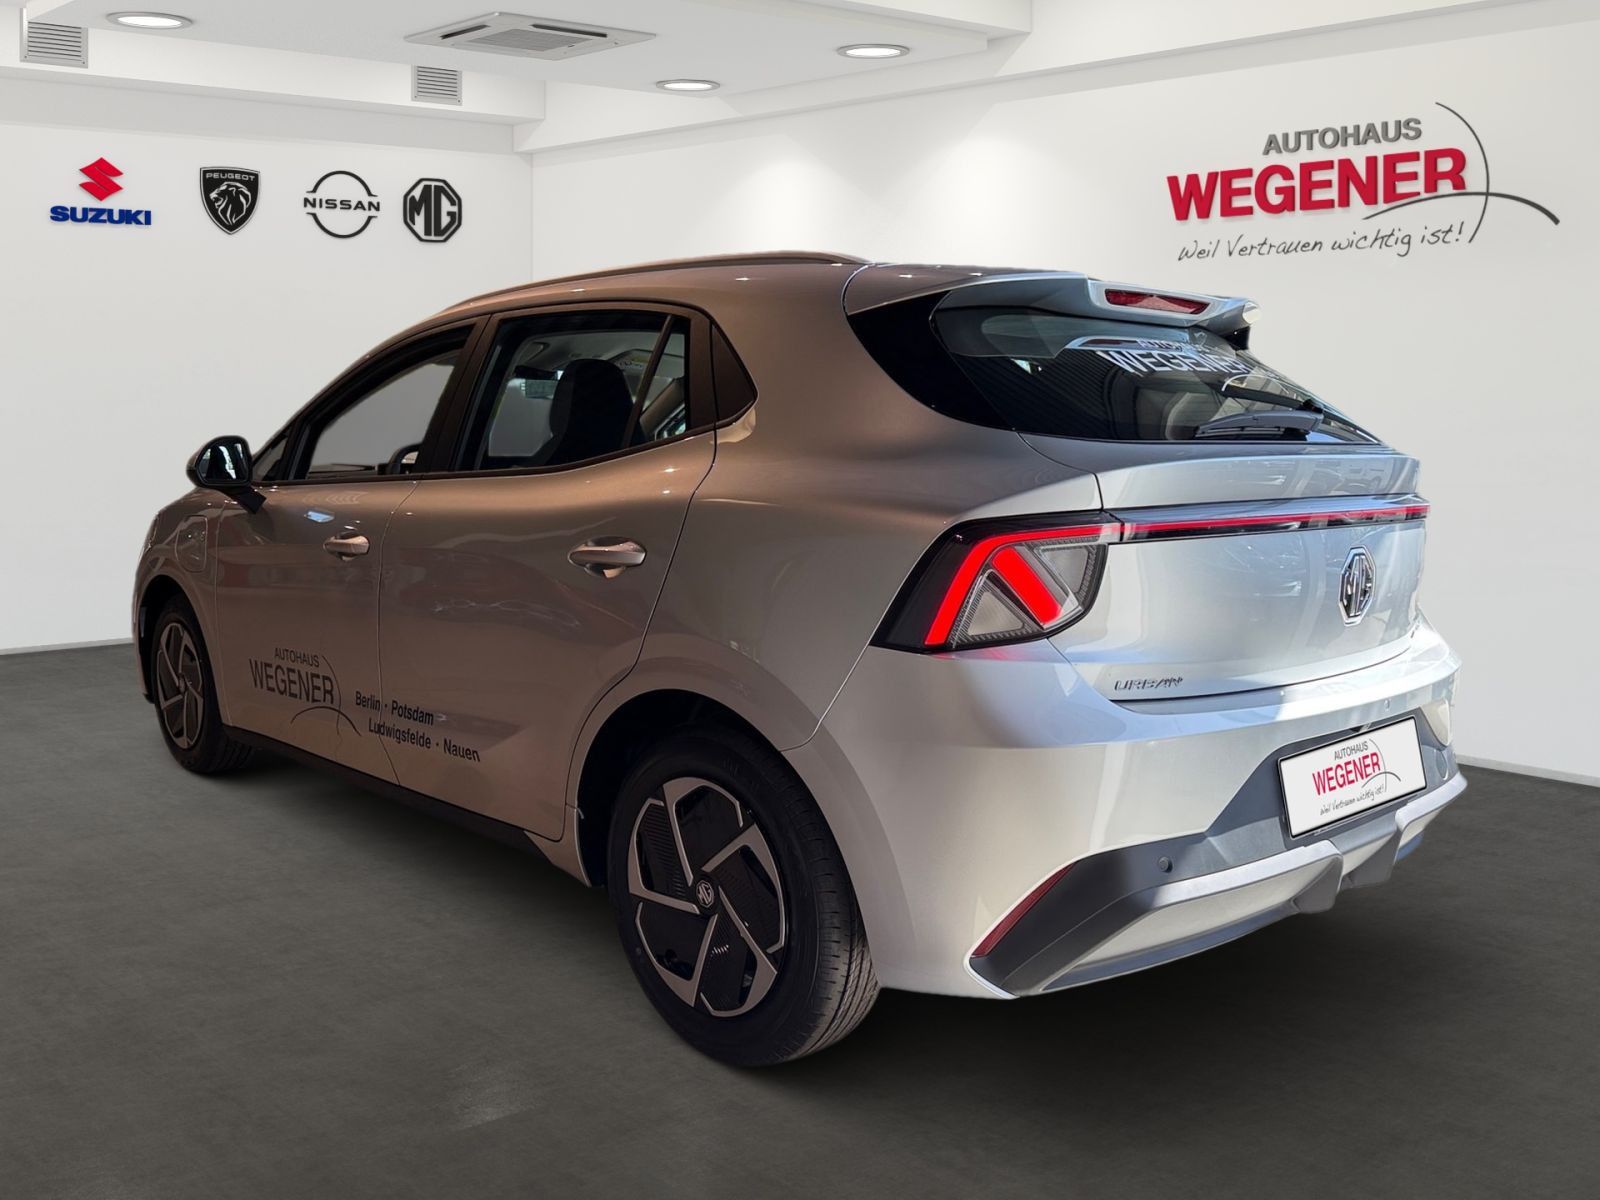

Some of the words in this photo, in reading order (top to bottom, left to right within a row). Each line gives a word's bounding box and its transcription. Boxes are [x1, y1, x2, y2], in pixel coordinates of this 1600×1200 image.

[1263, 118, 1422, 155] AUTOHAUS
[205, 172, 256, 182] PEUGEOT
[1167, 148, 1467, 221] WEGENER
[50, 205, 152, 226] SUZUKI
[303, 197, 380, 212] NISSAN
[408, 184, 457, 237] MG
[1178, 238, 1220, 262] Weil
[1226, 234, 1323, 257] Vertrauen
[1331, 230, 1413, 257] wichtig
[1420, 221, 1465, 245] ist!
[1097, 350, 1251, 378] WEGENER
[274, 648, 320, 668] AUTOHAUS
[249, 658, 334, 705] WEGENER
[1114, 677, 1183, 690] URBAN
[355, 691, 381, 712] Berlin
[391, 700, 434, 726] Potsdam
[368, 718, 431, 749] Ludwigsfelde
[443, 738, 480, 762] Nauen
[1334, 741, 1368, 761] AUTOHAUS
[1312, 753, 1380, 795] WEGENER
